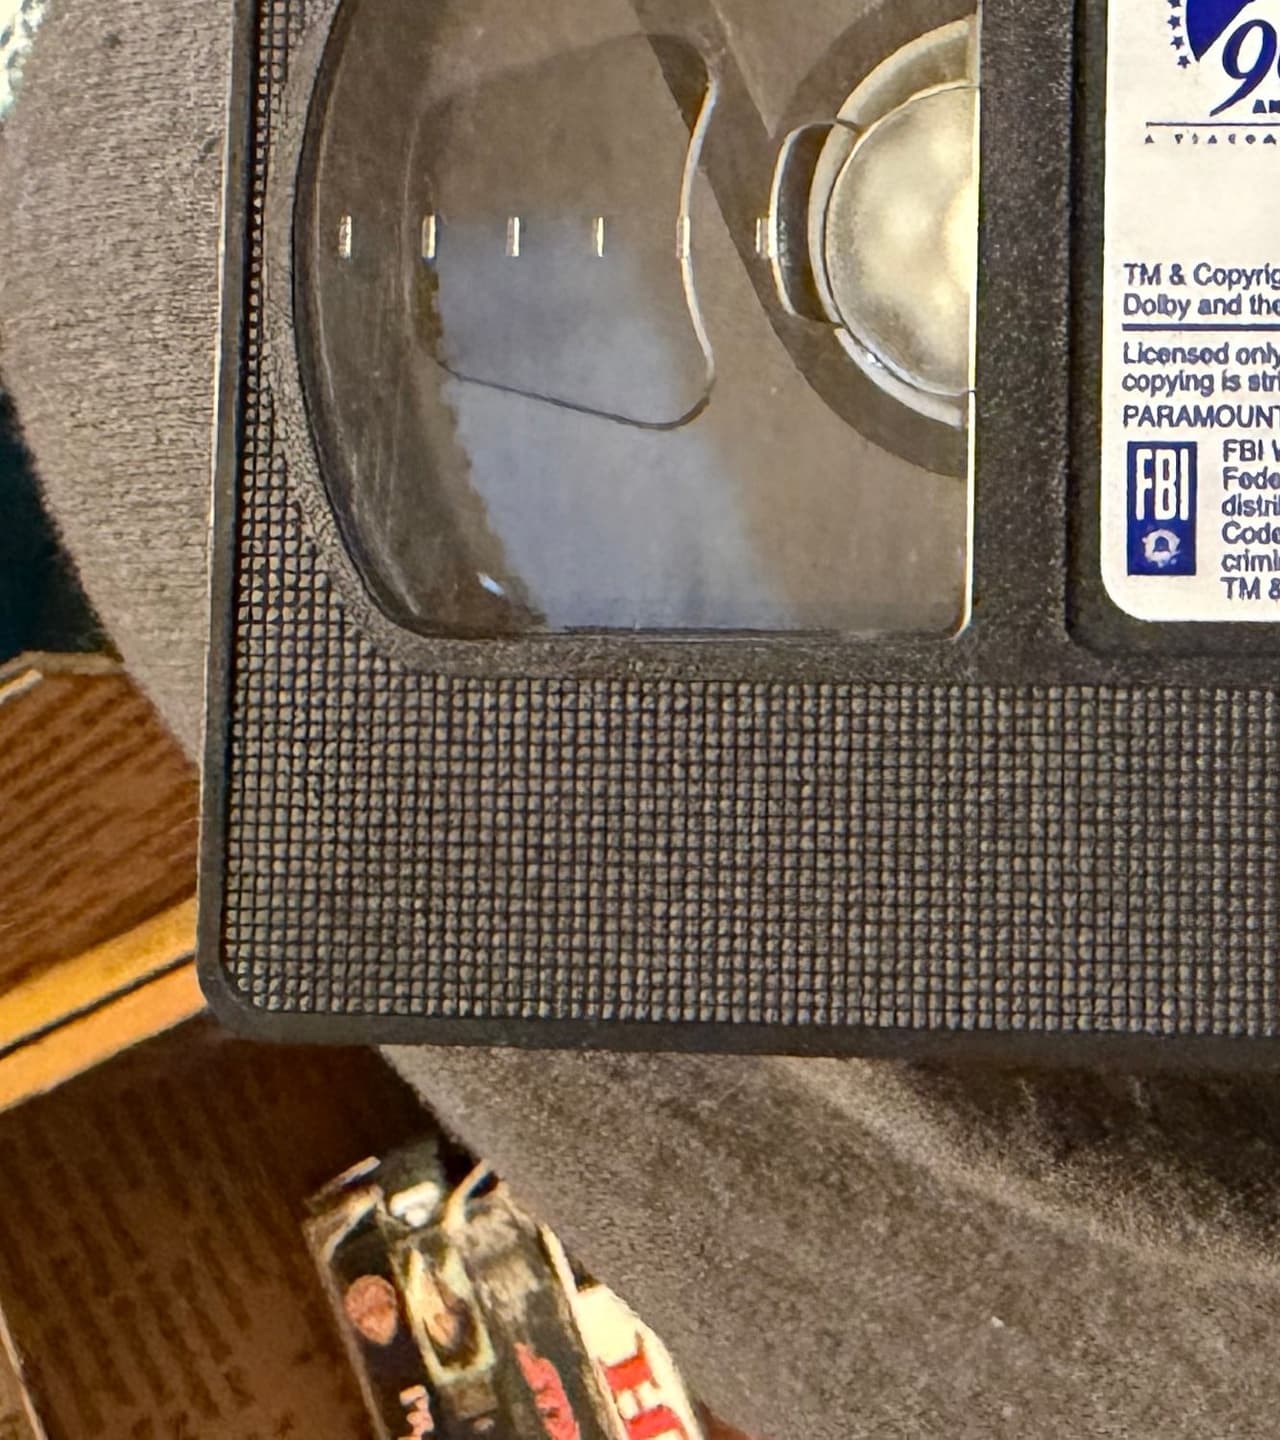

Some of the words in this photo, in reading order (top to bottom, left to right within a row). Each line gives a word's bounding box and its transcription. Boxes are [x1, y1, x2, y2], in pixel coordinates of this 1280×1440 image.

[1123, 261, 1162, 287] TM
[1168, 261, 1187, 287] &
[1123, 292, 1192, 324] Dolby
[1197, 292, 1242, 318] and
[1123, 341, 1230, 366] Licensed
[1222, 440, 1264, 464] FBI
[1135, 447, 1190, 522] FBI
